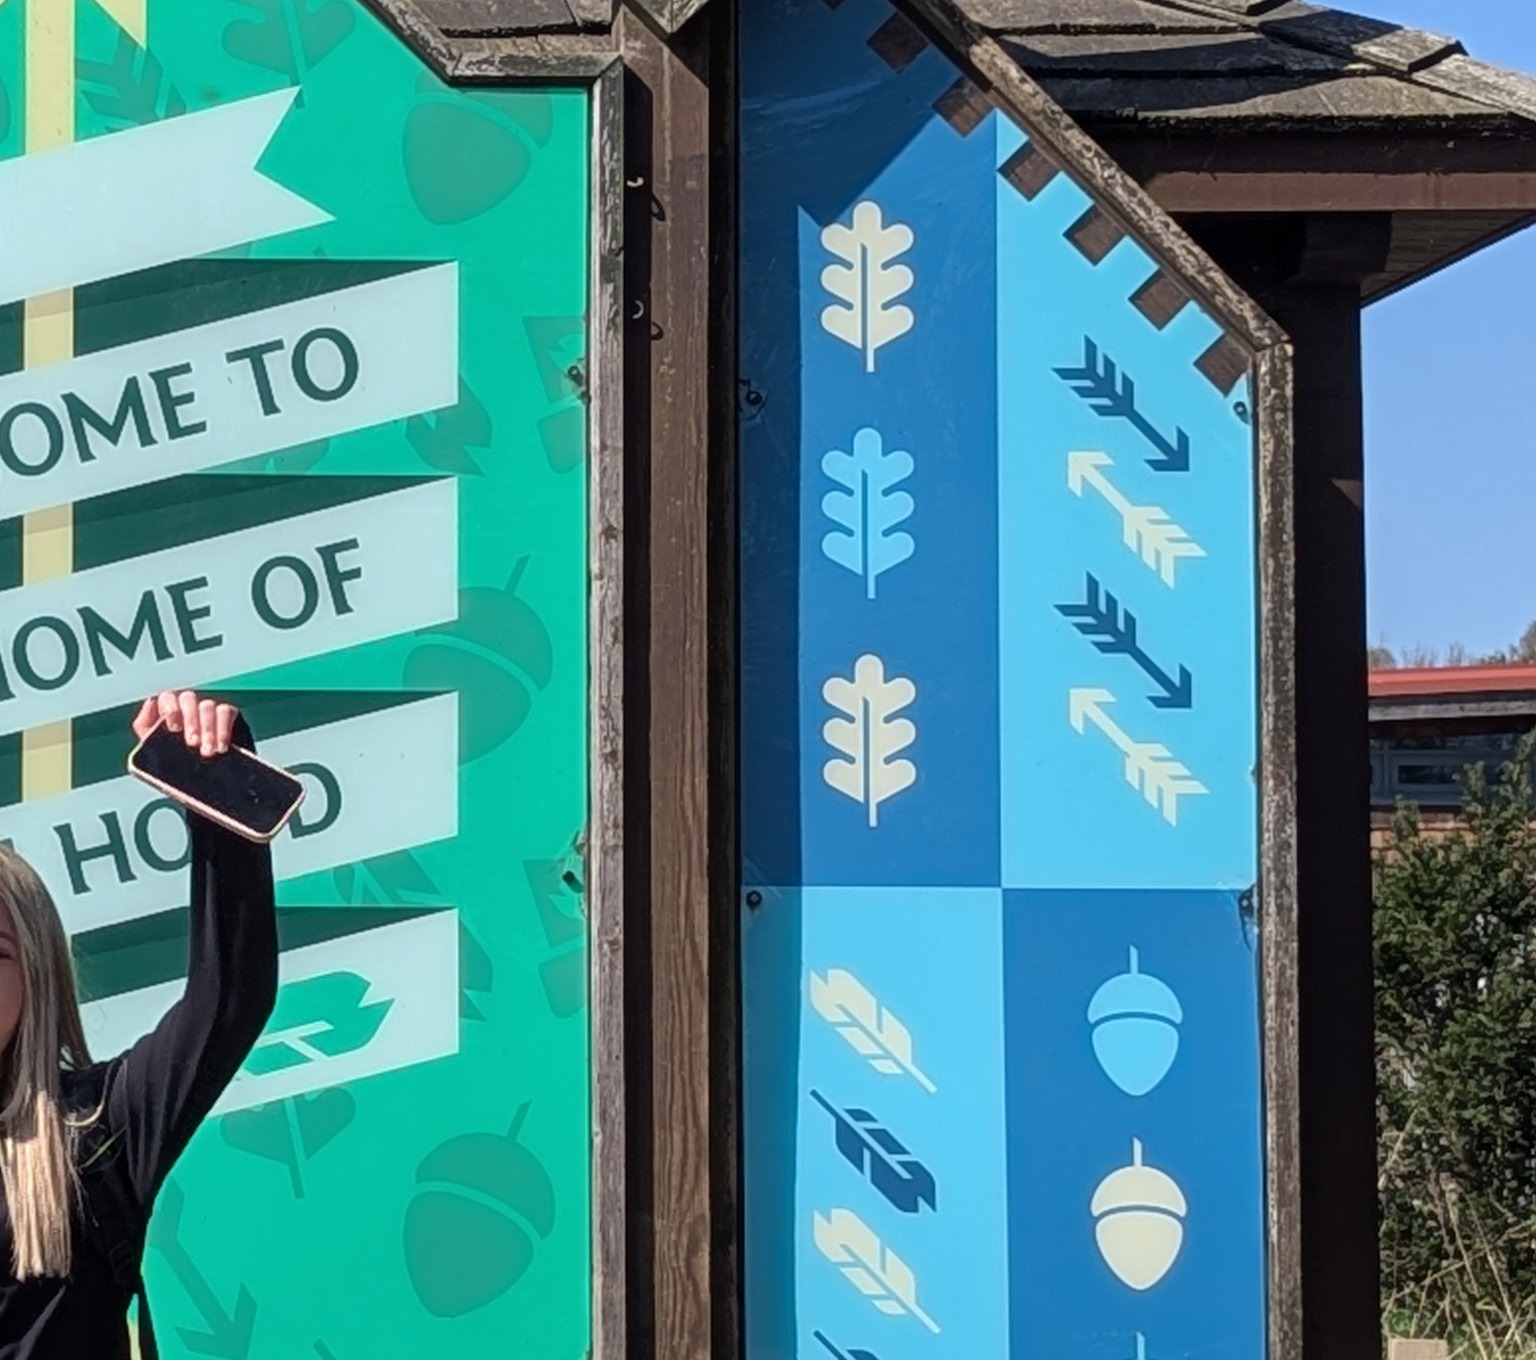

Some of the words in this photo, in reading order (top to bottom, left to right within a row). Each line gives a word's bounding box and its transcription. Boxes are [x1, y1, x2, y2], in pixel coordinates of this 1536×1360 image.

[225, 327, 359, 417] TO
[250, 538, 363, 630] OF
[54, 761, 343, 896] HOD
